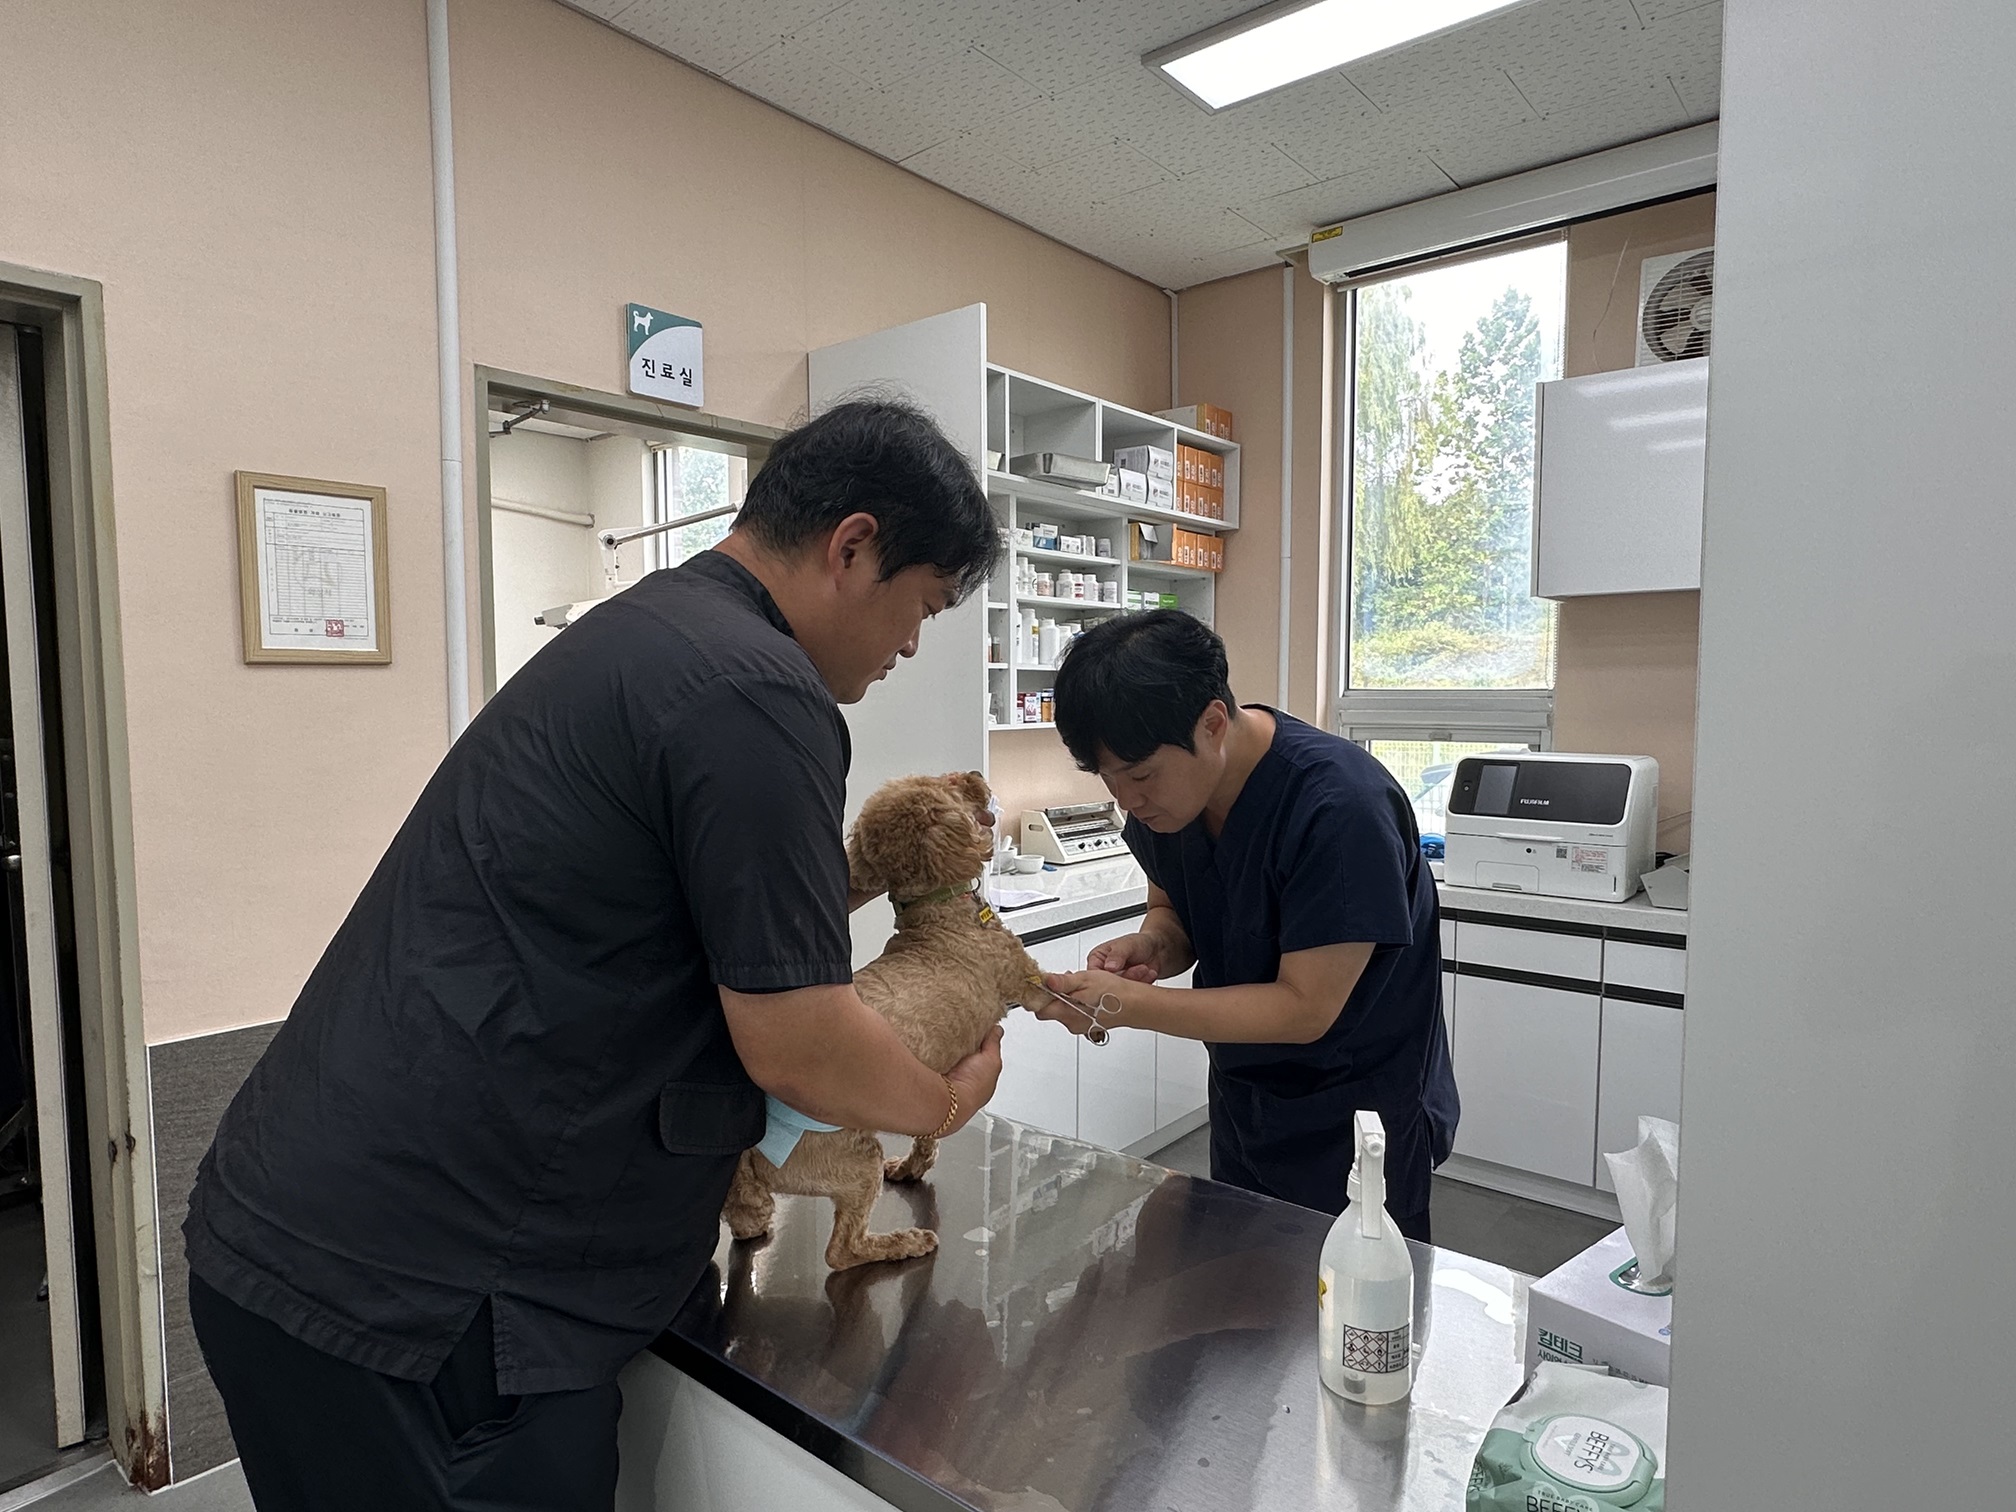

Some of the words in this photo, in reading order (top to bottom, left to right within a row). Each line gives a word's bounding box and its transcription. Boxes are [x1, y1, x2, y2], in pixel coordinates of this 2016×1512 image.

[641, 357, 693, 387] 진료실
[1520, 798, 1550, 806] FUJIFILM
[1538, 1327, 1583, 1360] 킴테크
[1574, 1429, 1610, 1473] BEFFYS
